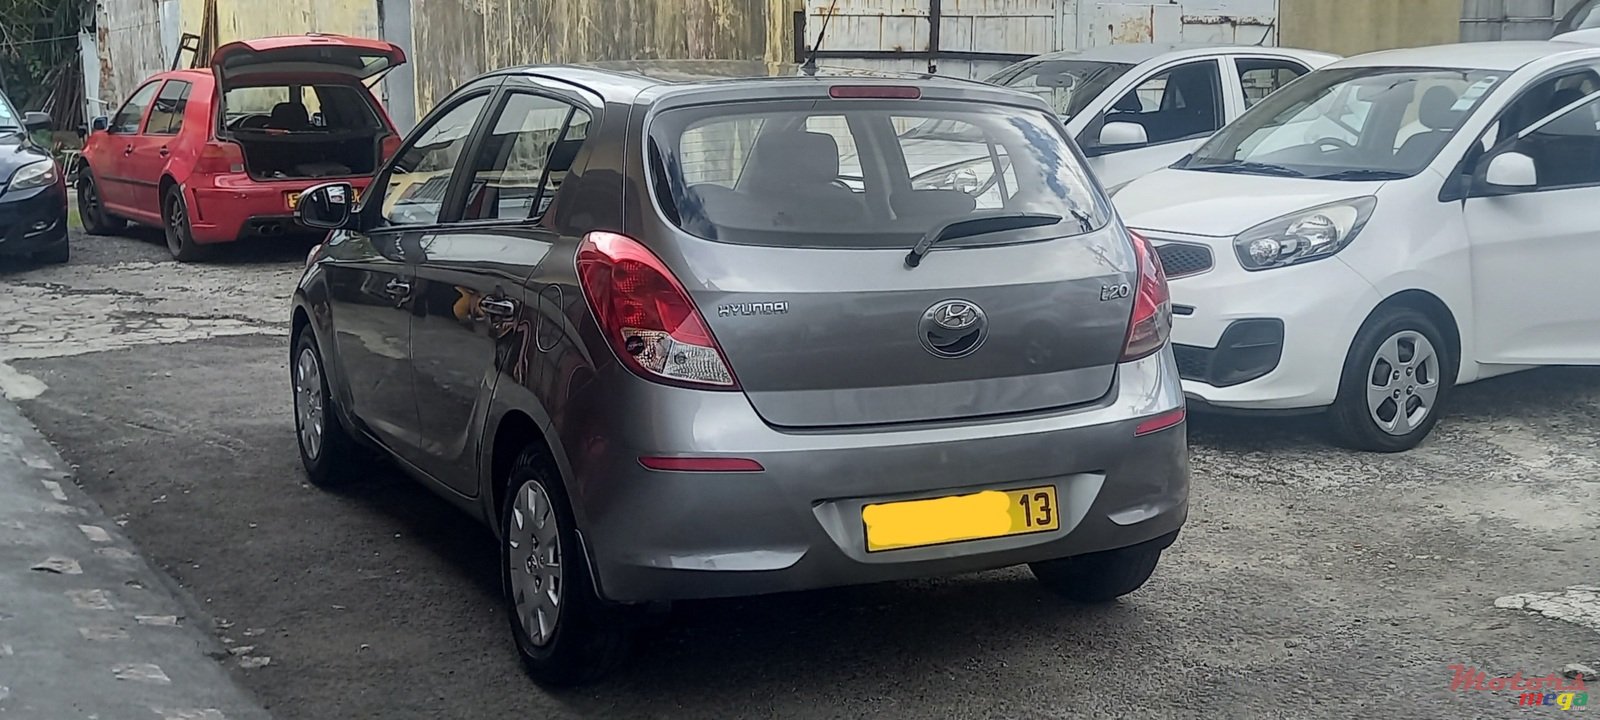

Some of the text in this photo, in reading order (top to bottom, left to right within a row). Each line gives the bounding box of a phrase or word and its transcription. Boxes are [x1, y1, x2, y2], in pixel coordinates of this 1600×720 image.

[1100, 284, 1130, 301] i20
[718, 301, 789, 317] HYUNDAI
[1019, 492, 1051, 527] 13
